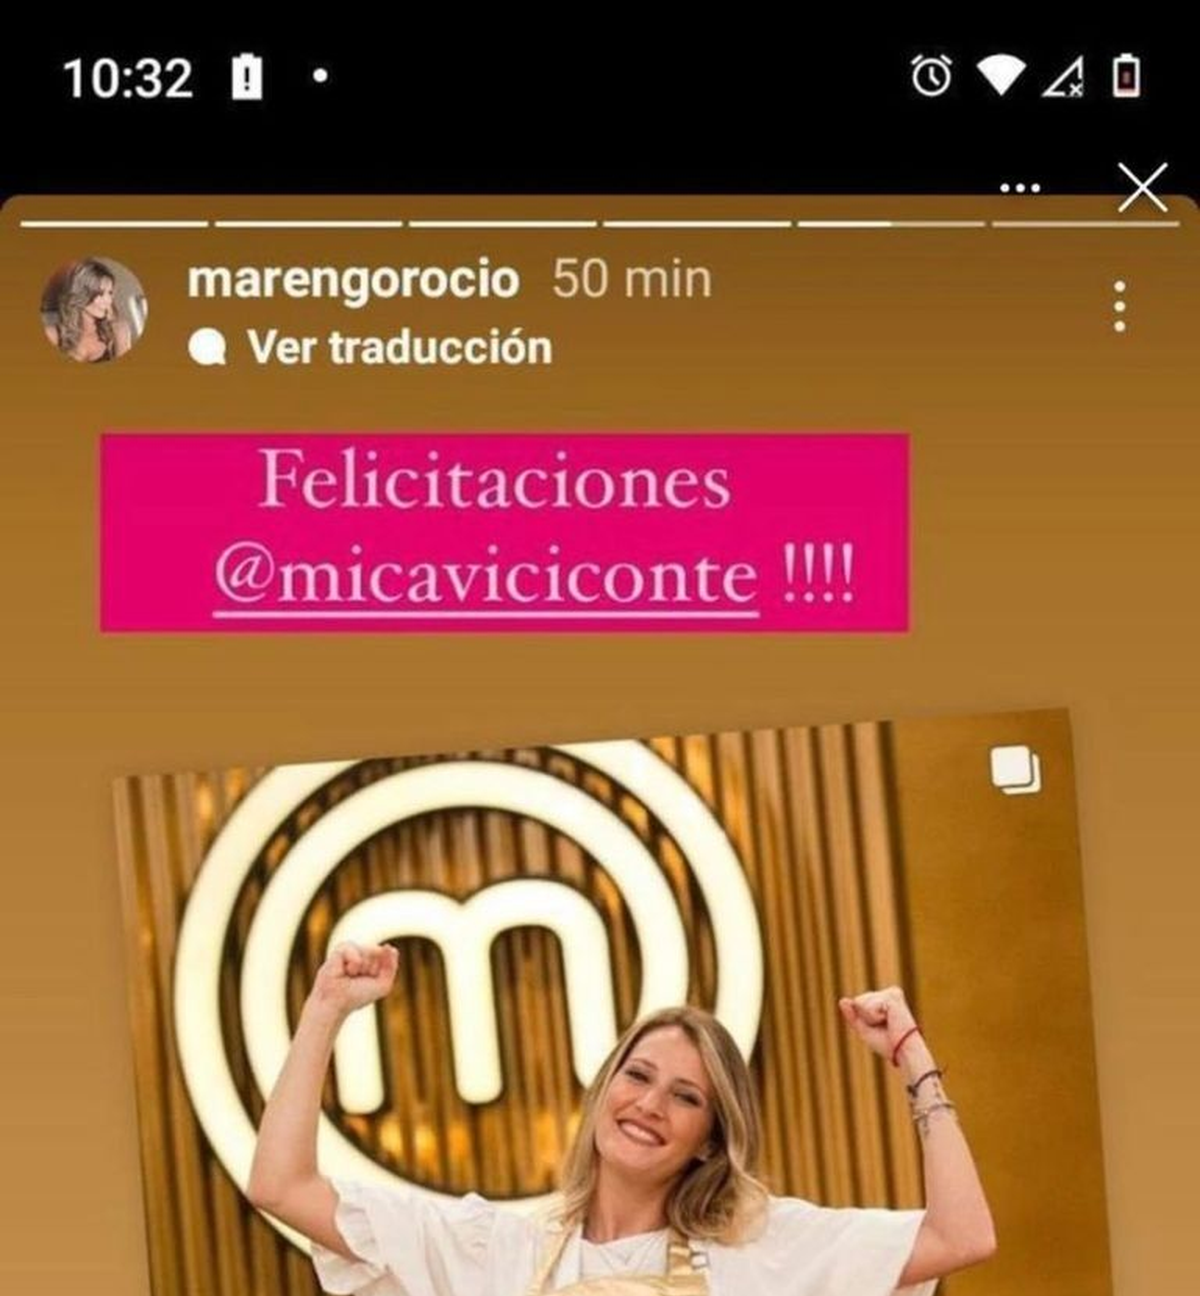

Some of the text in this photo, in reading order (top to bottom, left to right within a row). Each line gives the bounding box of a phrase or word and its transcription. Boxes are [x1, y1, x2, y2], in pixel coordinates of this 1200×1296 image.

[63, 57, 194, 98] 10:32
[188, 257, 711, 308] marengorocio 50 min
[247, 327, 552, 364] Ver traducción
